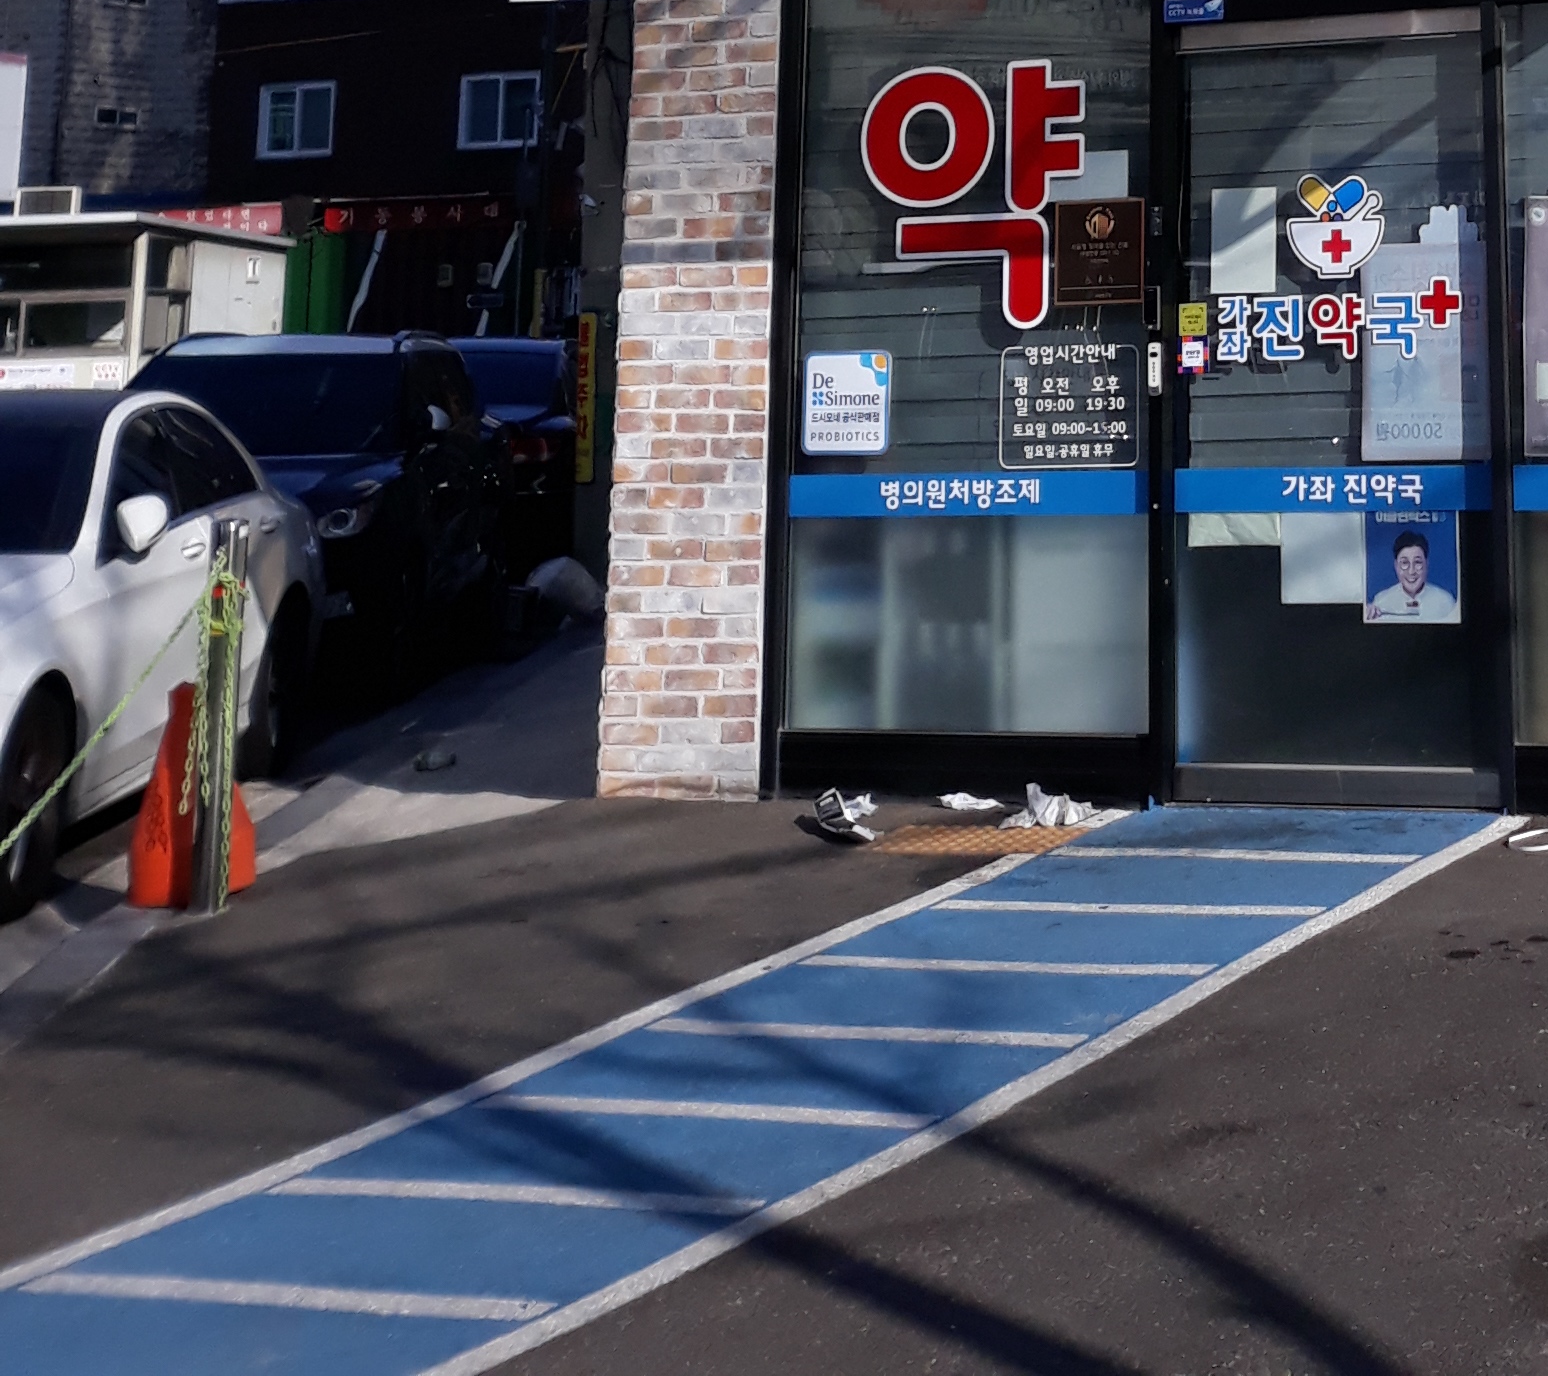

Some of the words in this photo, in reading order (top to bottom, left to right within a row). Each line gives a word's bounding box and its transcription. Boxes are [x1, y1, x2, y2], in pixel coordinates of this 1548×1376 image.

[860, 59, 1086, 330] 약
[1217, 295, 1252, 362] 가좌
[1024, 343, 1116, 366] 영업시간안내
[812, 372, 834, 389] De
[1041, 377, 1070, 396] 오전
[1091, 375, 1120, 394] 오후
[824, 390, 880, 407] Simone
[1035, 398, 1075, 412] 09:00
[811, 412, 840, 423] 드시모네
[810, 431, 880, 442] PROBIOTICS
[1012, 423, 1046, 439] 토요일
[1093, 443, 1114, 458] 휴무
[880, 478, 1041, 509] 병의원처방조제
[1282, 475, 1336, 503] 가좌
[1342, 473, 1425, 505] 진약국
